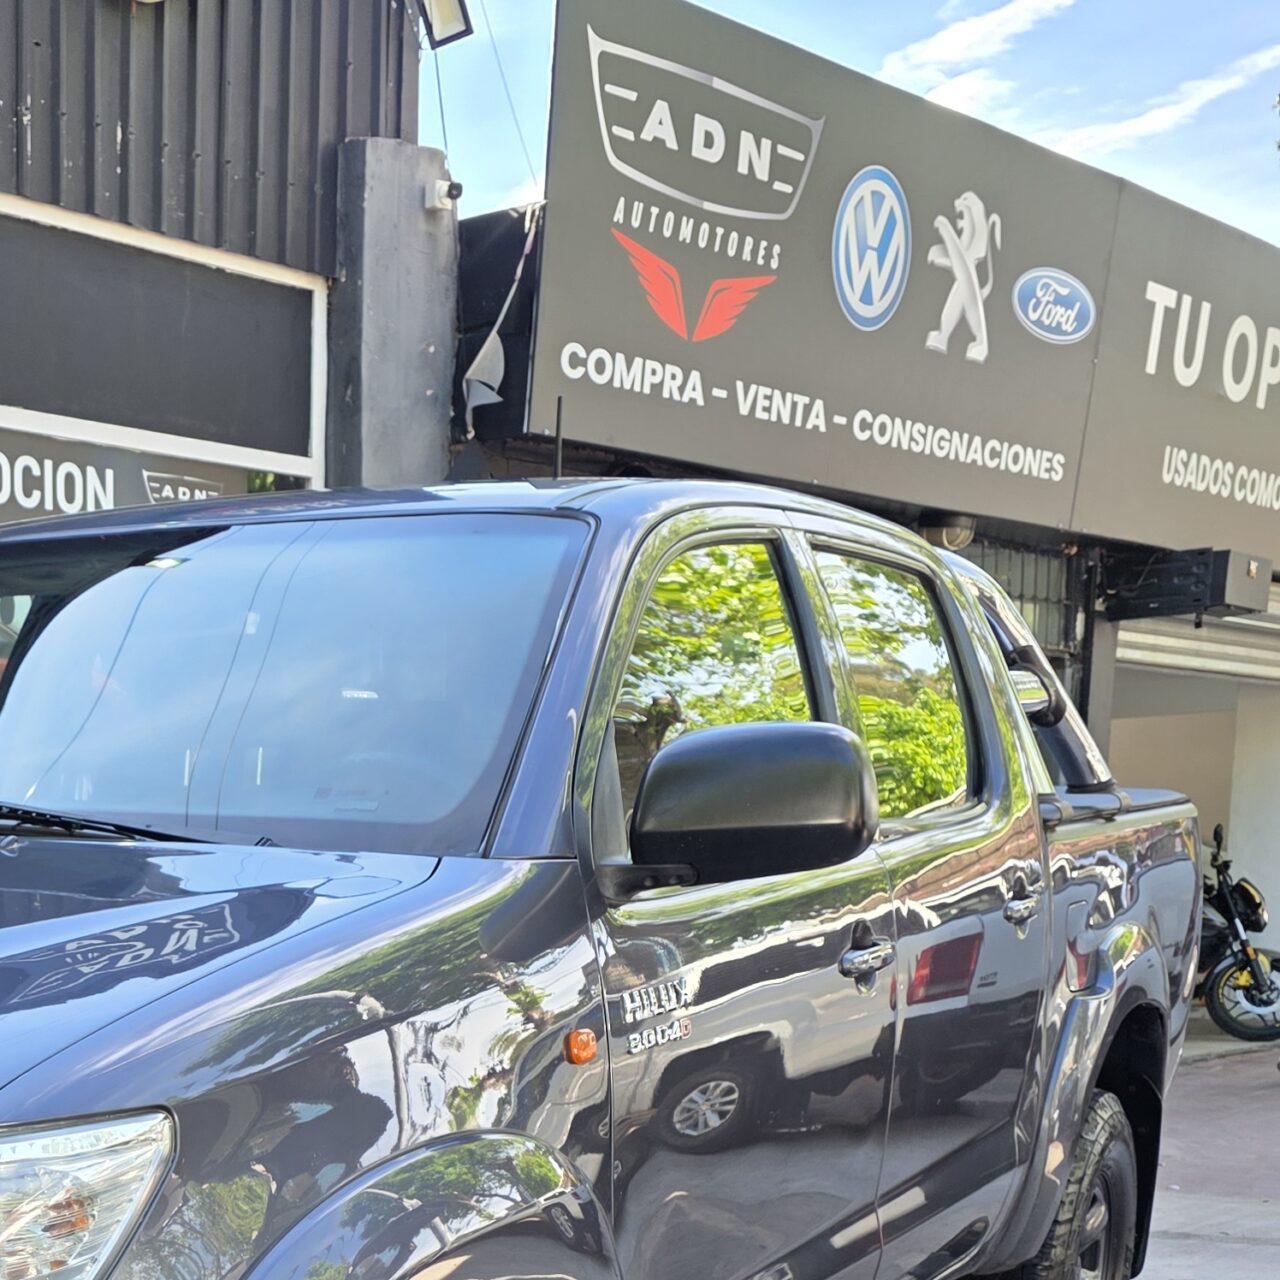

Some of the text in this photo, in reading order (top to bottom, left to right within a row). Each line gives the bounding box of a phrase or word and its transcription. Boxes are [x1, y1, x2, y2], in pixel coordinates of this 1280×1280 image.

[639, 98, 772, 182] ADN
[612, 196, 782, 270] AUTOMOTORES
[1026, 277, 1082, 334] Ford
[1144, 280, 1212, 388] TU
[560, 342, 705, 406] COMPRA
[735, 381, 827, 433] VENTA
[853, 409, 1066, 482] CONSIGNACIONES
[161, 484, 207, 501] ADN
[1162, 445, 1234, 498] USADOS
[622, 976, 692, 1024] HILUX
